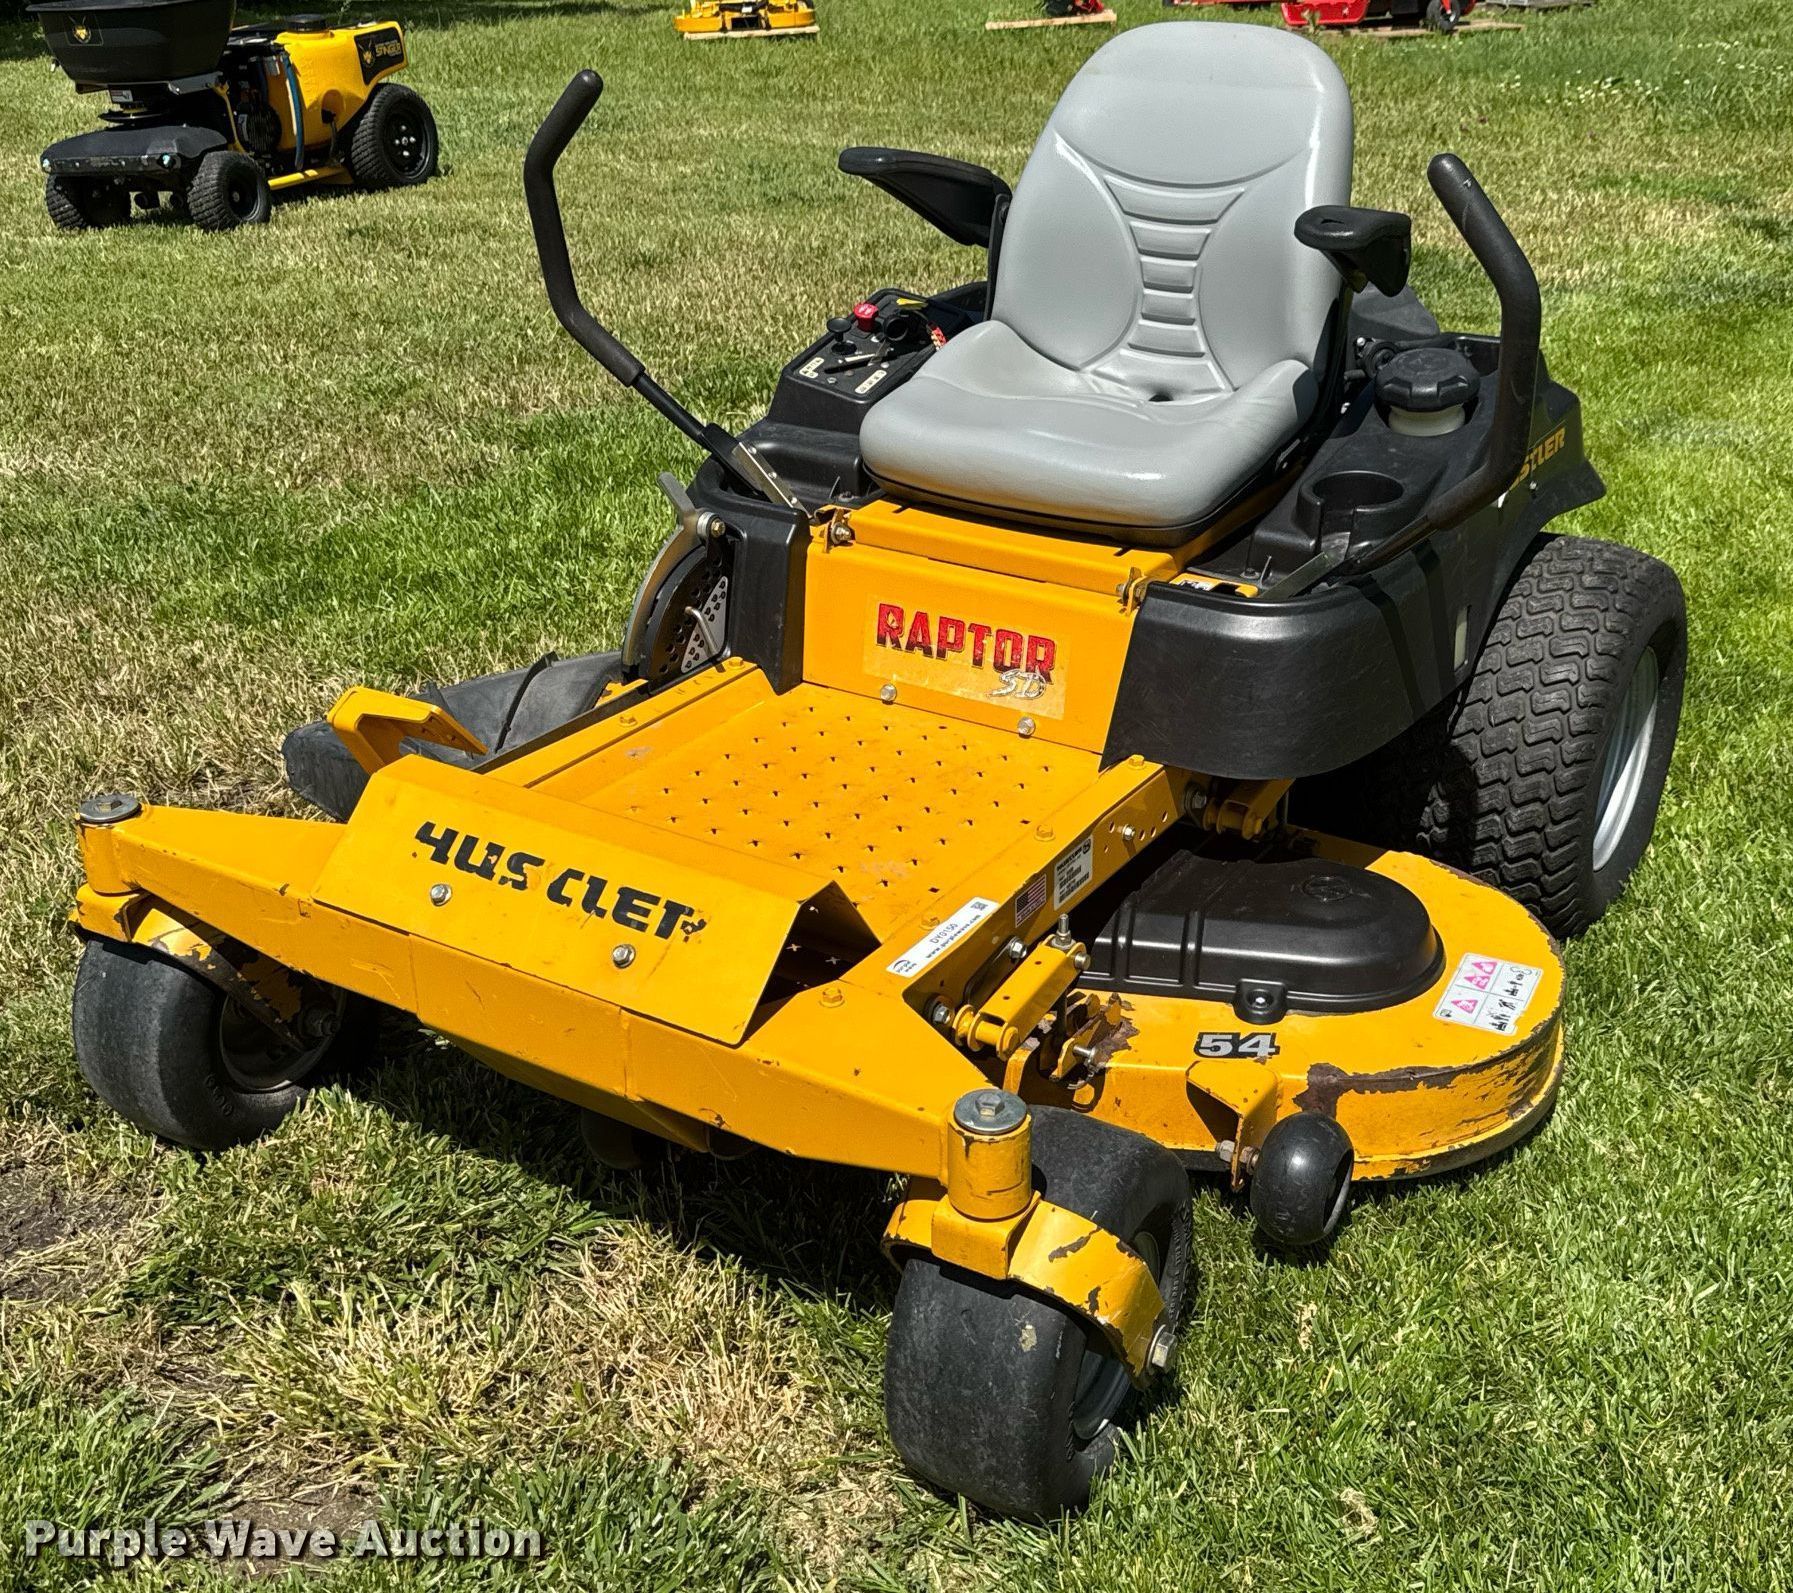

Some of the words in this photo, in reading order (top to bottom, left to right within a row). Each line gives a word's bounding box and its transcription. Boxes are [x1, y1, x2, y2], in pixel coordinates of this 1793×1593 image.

[877, 603, 1057, 685] RAPTOR
[930, 923, 959, 944] DY0150
[1196, 1034, 1276, 1058] 54
